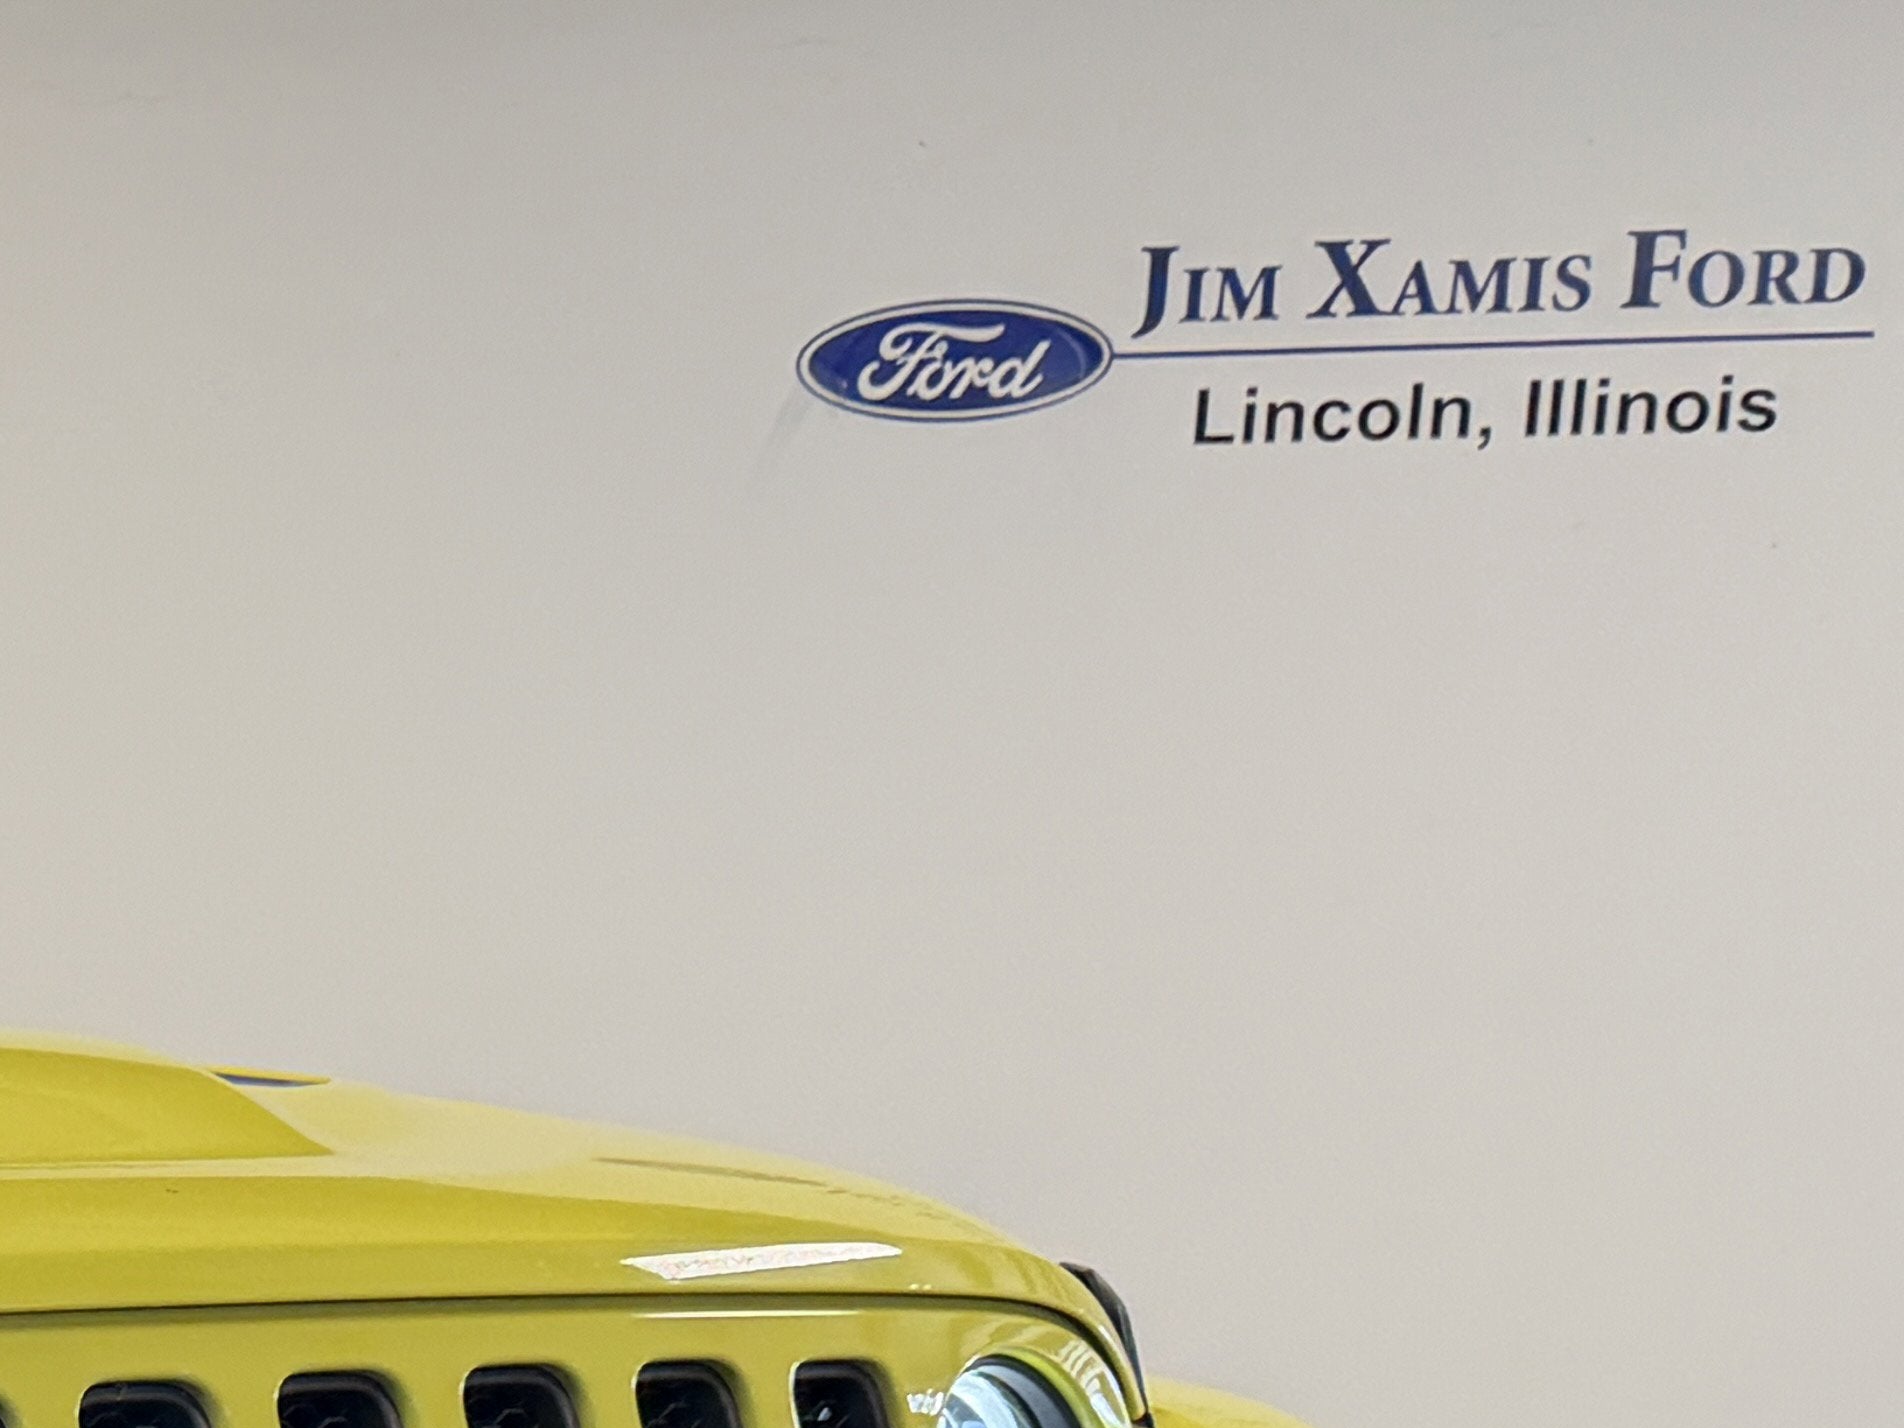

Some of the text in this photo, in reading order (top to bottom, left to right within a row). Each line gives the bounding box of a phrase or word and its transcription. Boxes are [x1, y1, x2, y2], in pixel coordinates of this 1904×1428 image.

[1130, 229, 1866, 339] JIM XAMIS FORD
[857, 321, 1052, 401] Ford
[1193, 374, 1777, 450] Lincoln, Illinois
